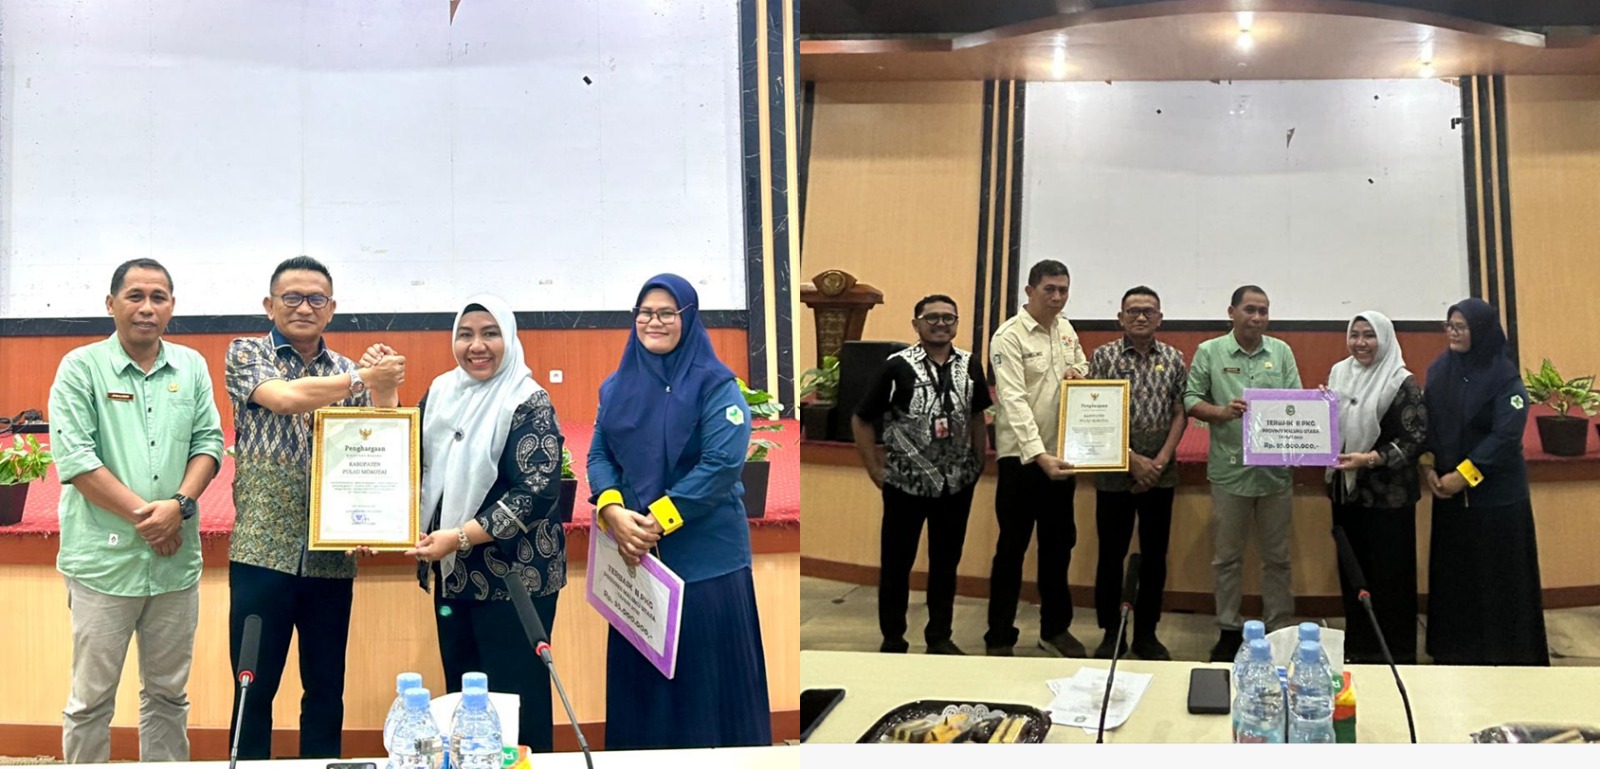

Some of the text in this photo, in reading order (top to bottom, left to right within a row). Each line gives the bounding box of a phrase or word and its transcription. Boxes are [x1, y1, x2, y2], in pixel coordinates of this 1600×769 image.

[344, 445, 386, 453] Penghargaan
[608, 564, 633, 591] TERBAIK
[640, 593, 653, 610] PKG
